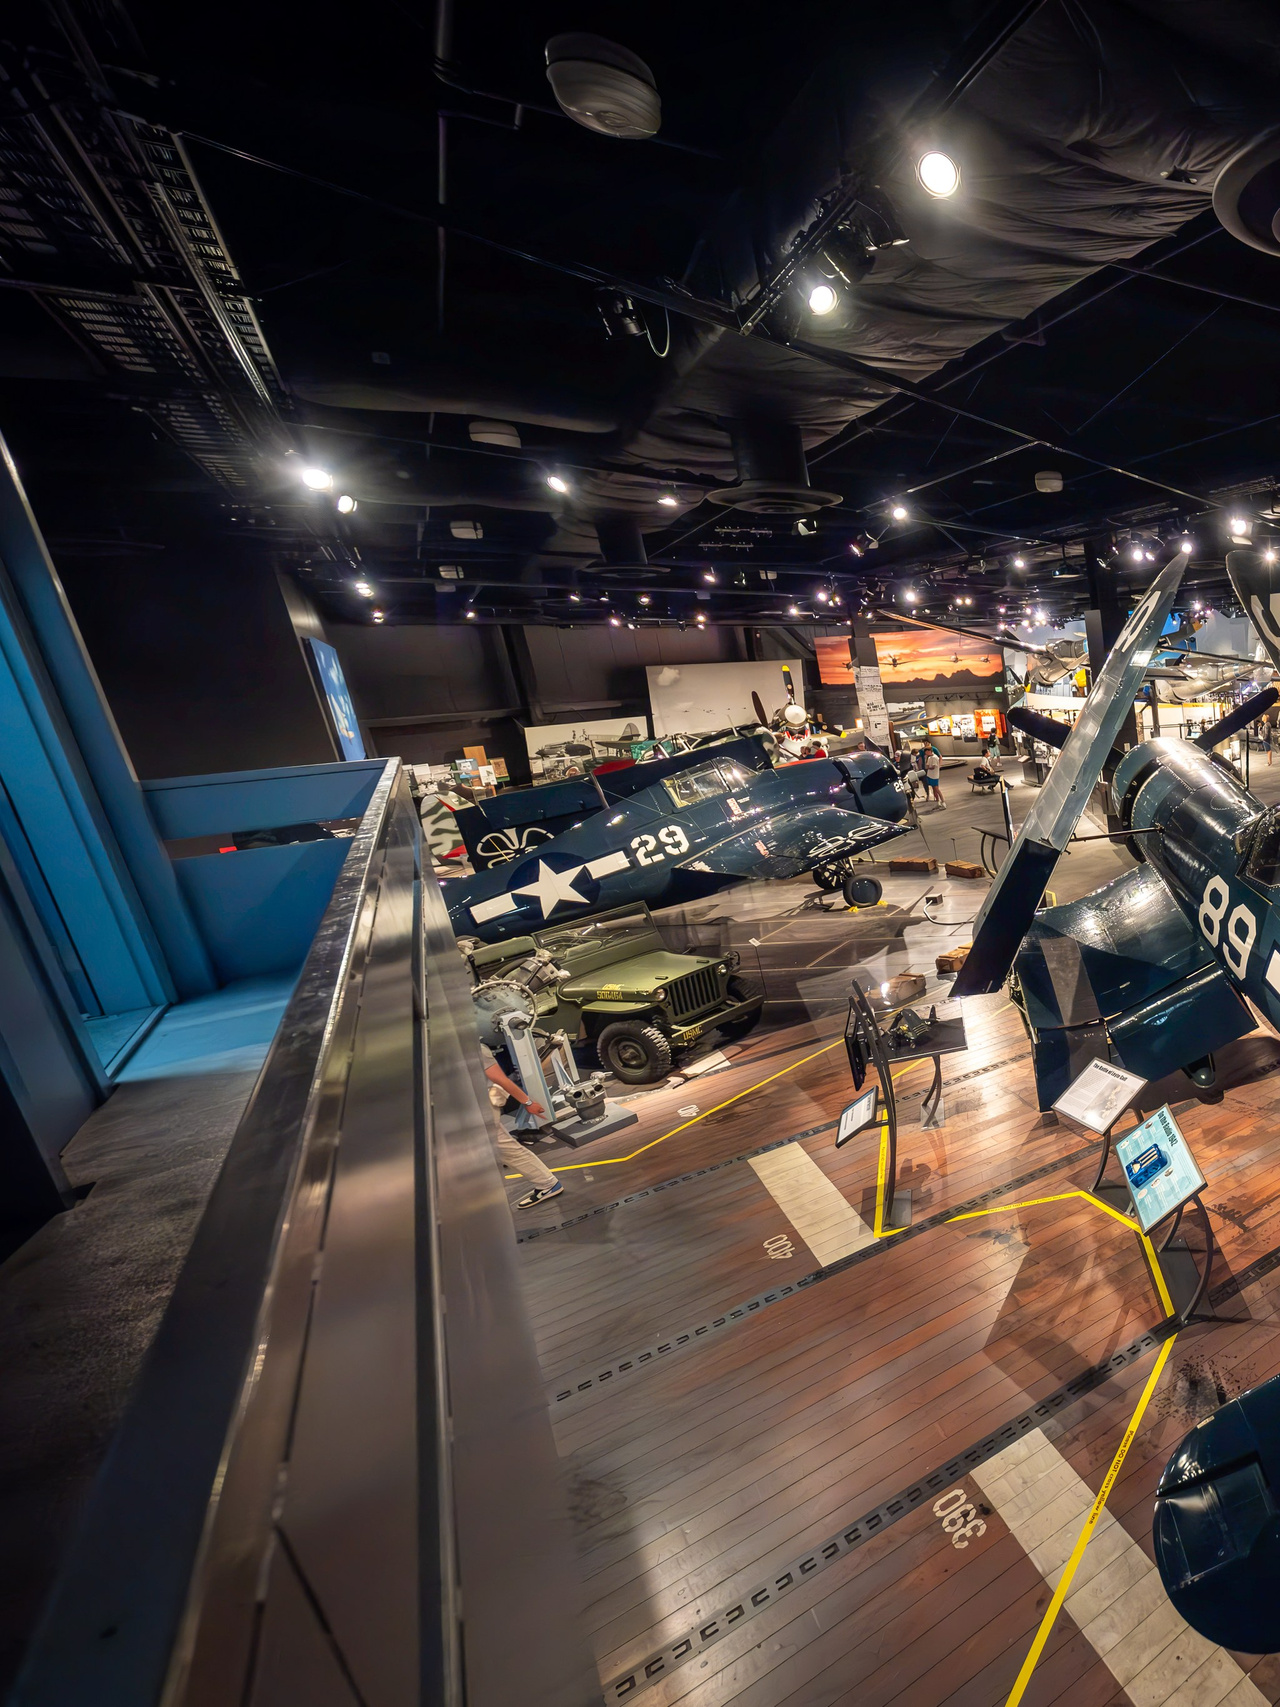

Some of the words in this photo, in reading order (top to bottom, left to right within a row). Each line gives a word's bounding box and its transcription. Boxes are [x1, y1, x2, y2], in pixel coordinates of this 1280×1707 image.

[630, 824, 690, 867] 29
[1198, 874, 1256, 980] 89
[682, 1025, 703, 1041] USMC
[762, 1234, 796, 1260] 400
[1118, 1449, 1126, 1459] DO
[1112, 1459, 1121, 1473] NOT
[1104, 1473, 1114, 1489] cross
[1095, 1489, 1107, 1512] yellow
[932, 1488, 987, 1549] 390
[1088, 1512, 1099, 1525] line
